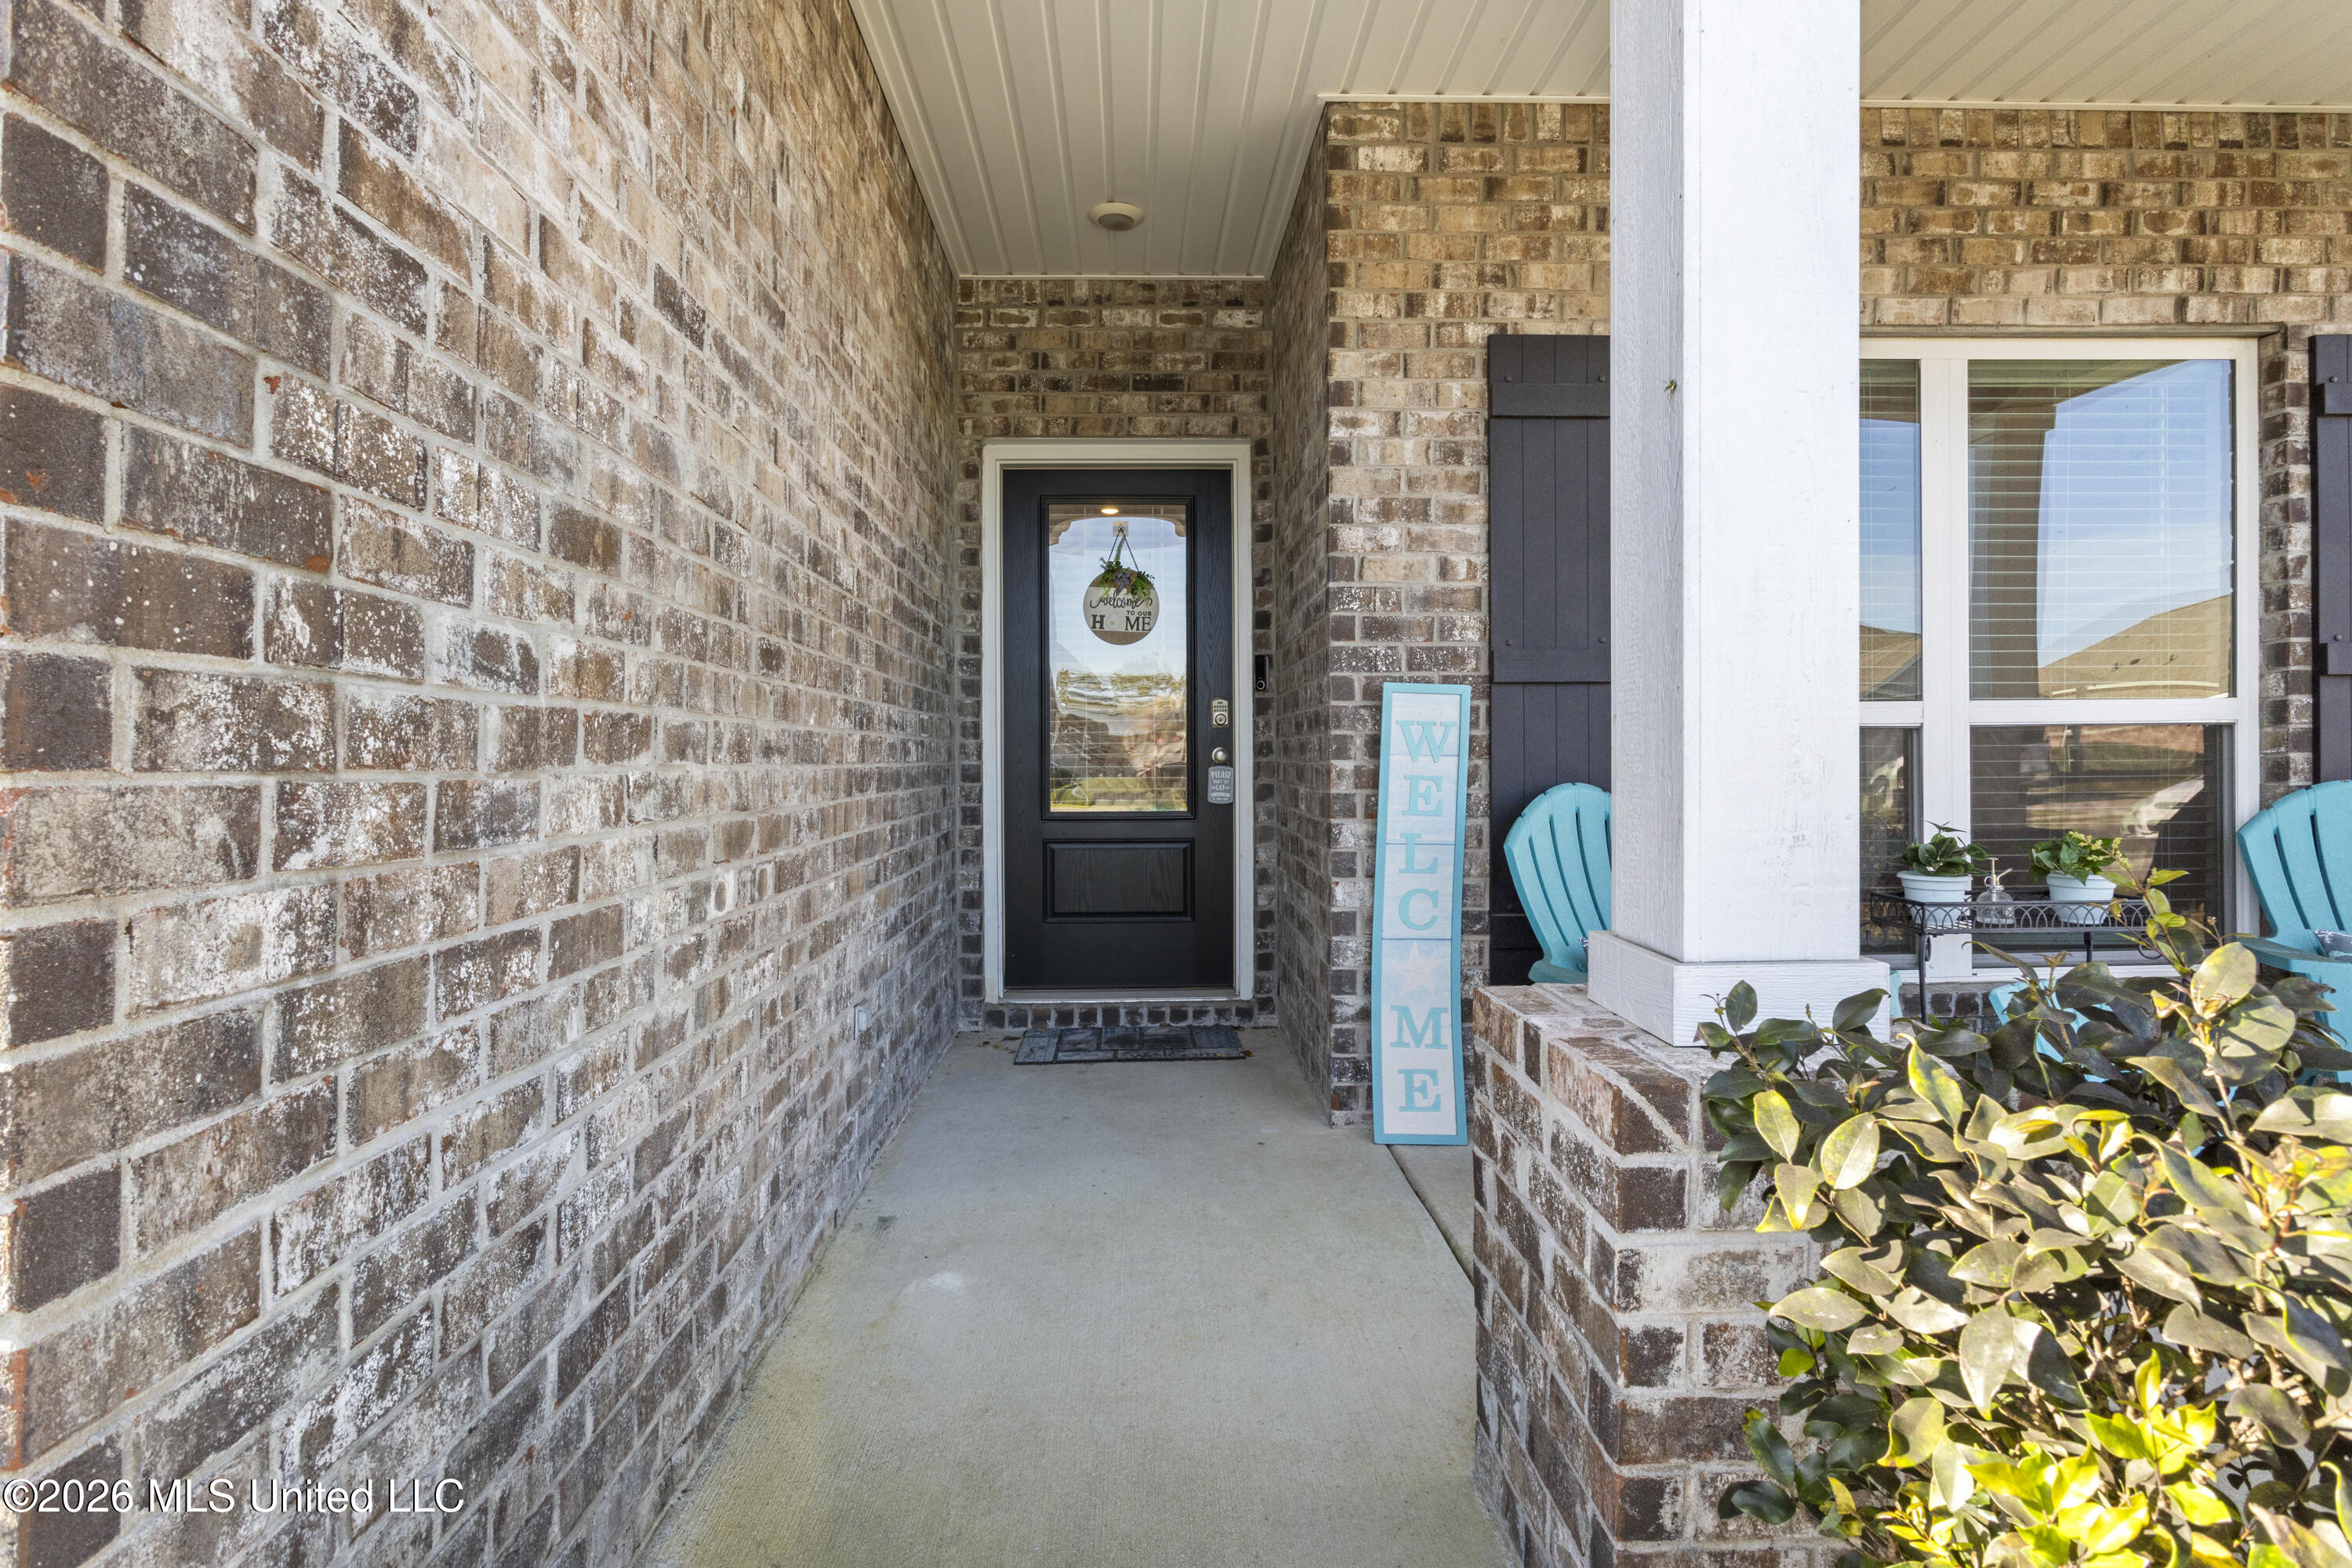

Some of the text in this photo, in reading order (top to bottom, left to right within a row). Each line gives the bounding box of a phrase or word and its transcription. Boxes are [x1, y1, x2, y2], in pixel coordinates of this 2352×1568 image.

[1090, 590, 1152, 609] welcome
[1091, 614, 1152, 631] HME
[1389, 720, 1457, 1112] WELCME
